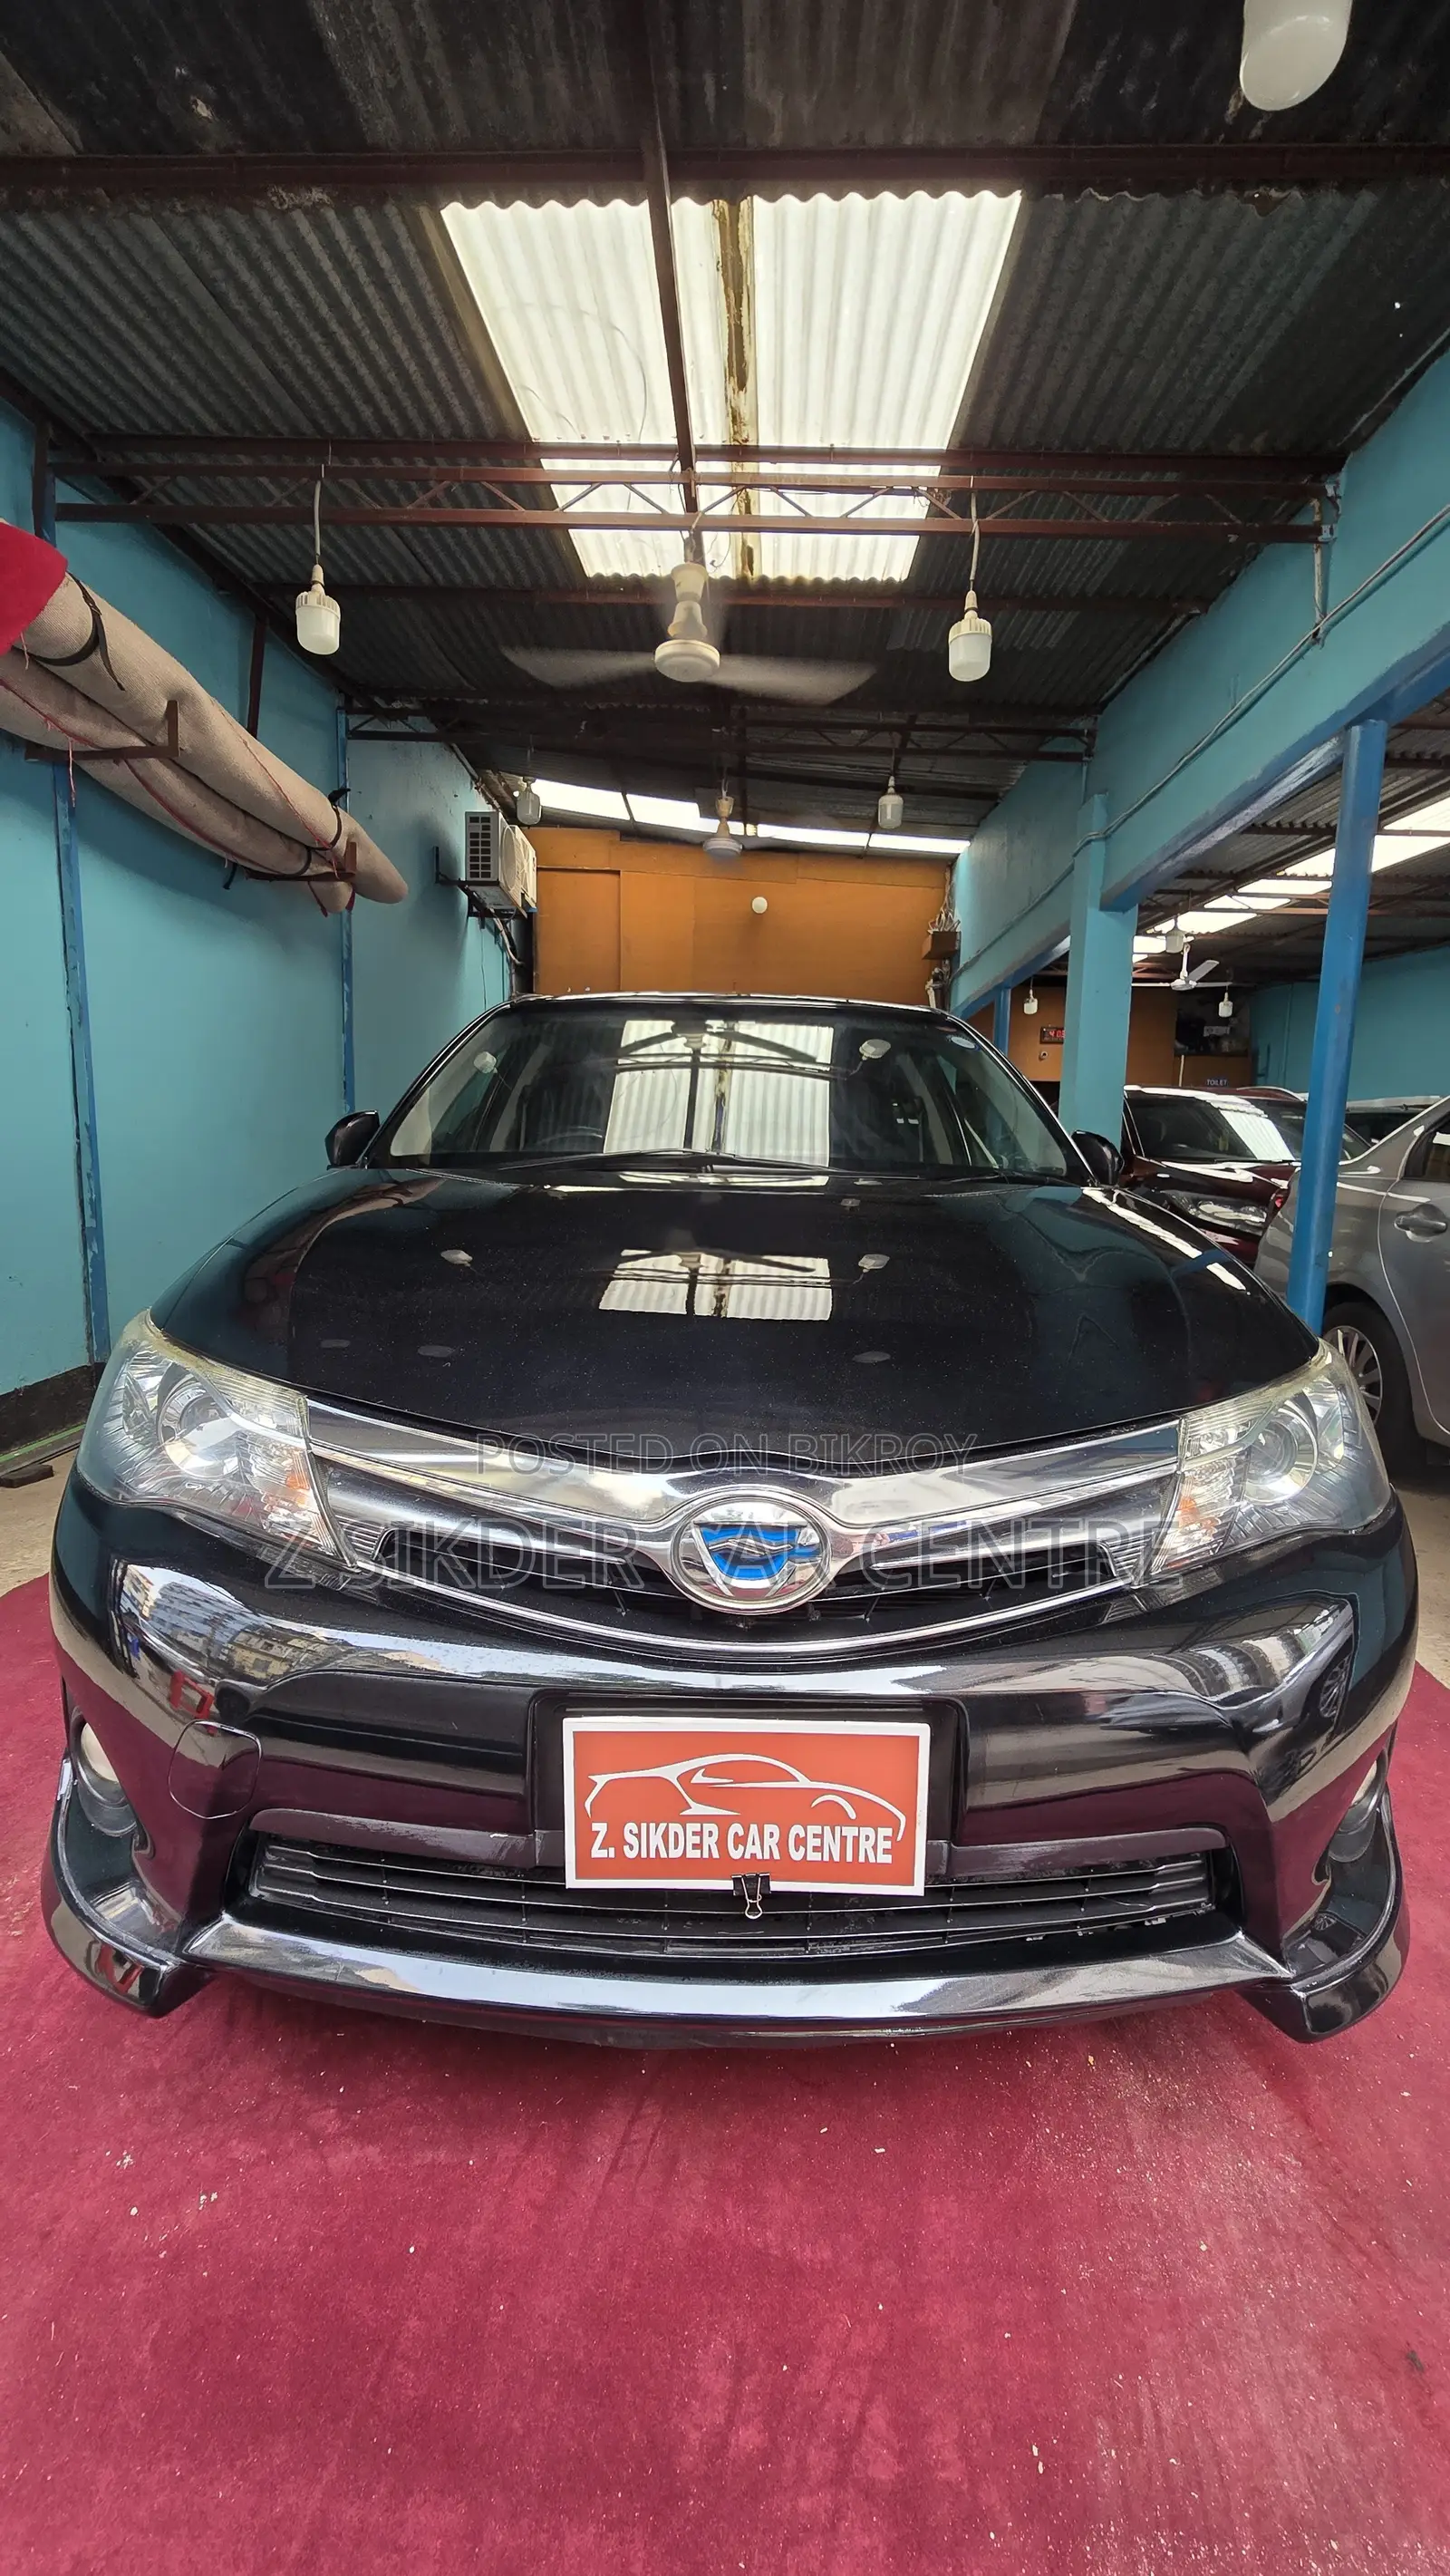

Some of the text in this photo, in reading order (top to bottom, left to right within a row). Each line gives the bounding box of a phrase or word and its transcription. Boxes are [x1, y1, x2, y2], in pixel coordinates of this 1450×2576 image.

[1206, 1079, 1228, 1087] TOILET
[591, 1822, 893, 1864] Z. SIKDER CAR CENTRE
